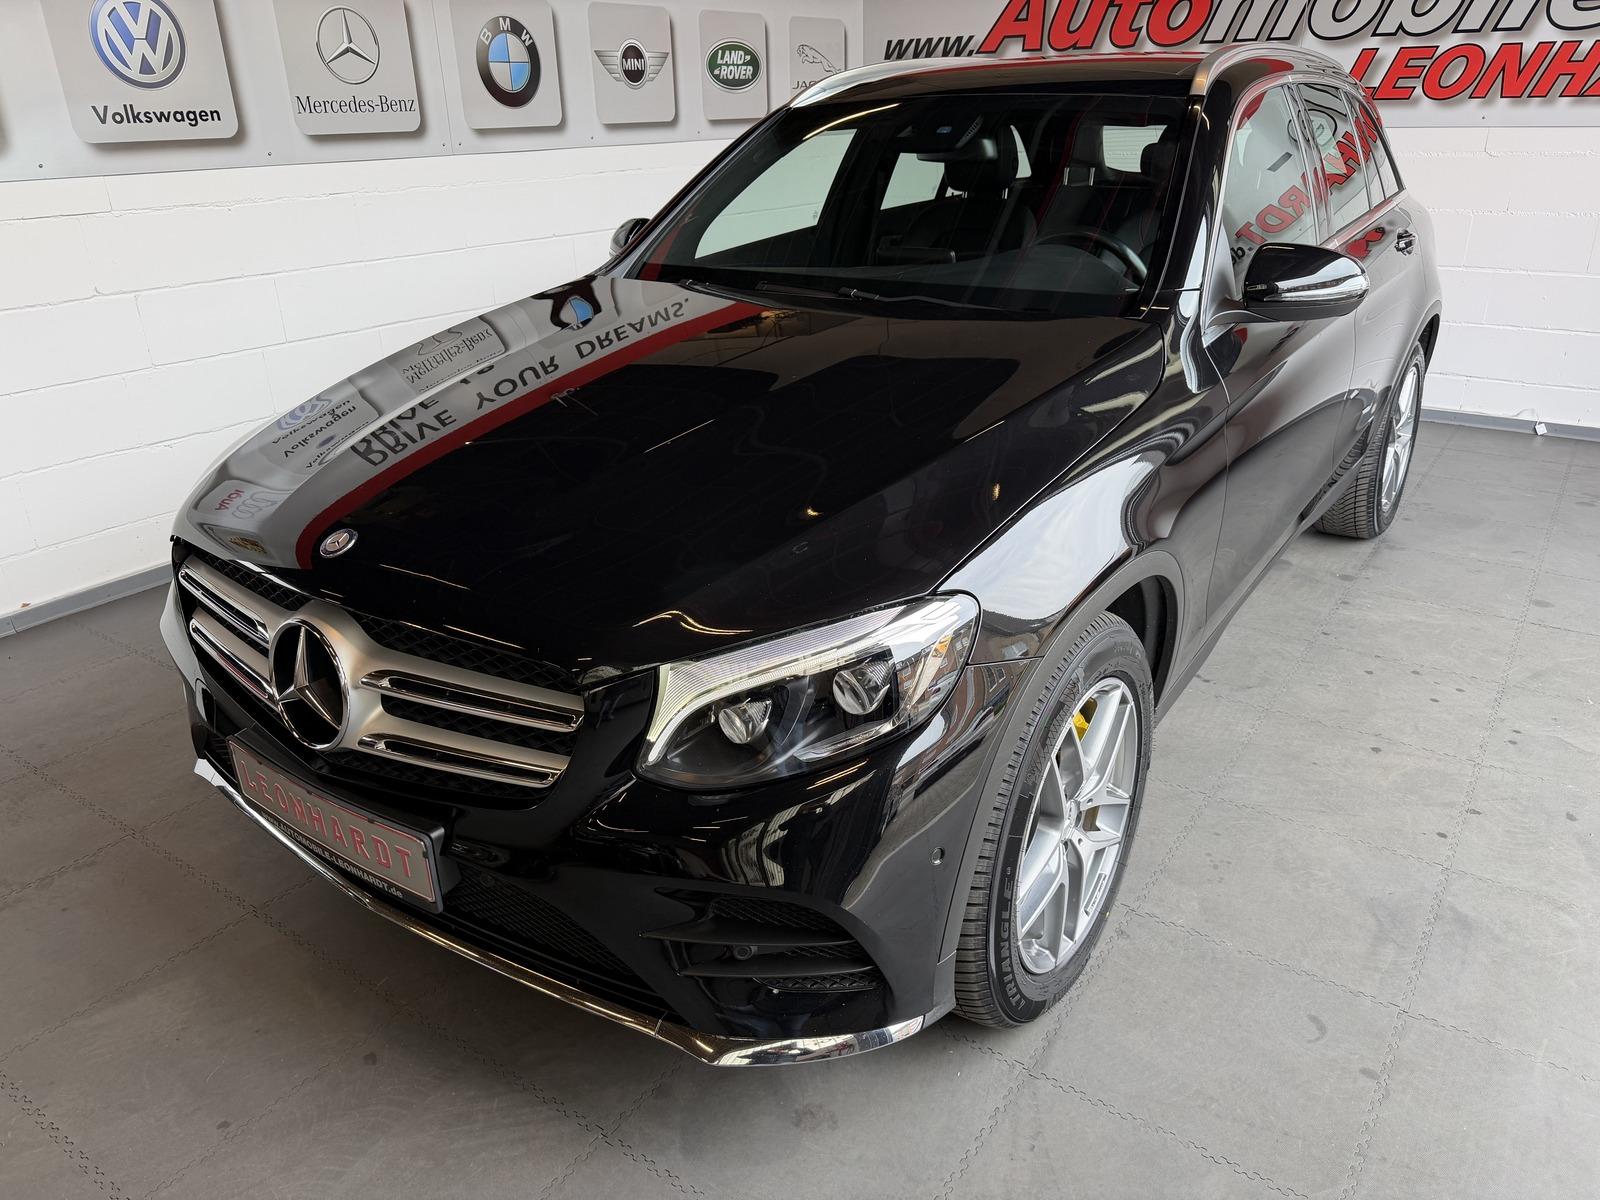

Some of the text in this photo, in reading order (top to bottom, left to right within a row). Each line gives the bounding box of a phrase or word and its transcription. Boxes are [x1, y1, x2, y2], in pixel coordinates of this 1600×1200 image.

[480, 17, 533, 46] BMW
[622, 58, 645, 71] MINI
[717, 50, 745, 64] LAND
[720, 65, 753, 80] ROVER
[1347, 40, 1600, 100] LEONH
[91, 104, 221, 127] Volkswagen
[295, 95, 416, 114] Mercedes-Benz
[240, 760, 412, 877] LEONHARDT
[1000, 878, 1017, 1006] TRIANGLE
